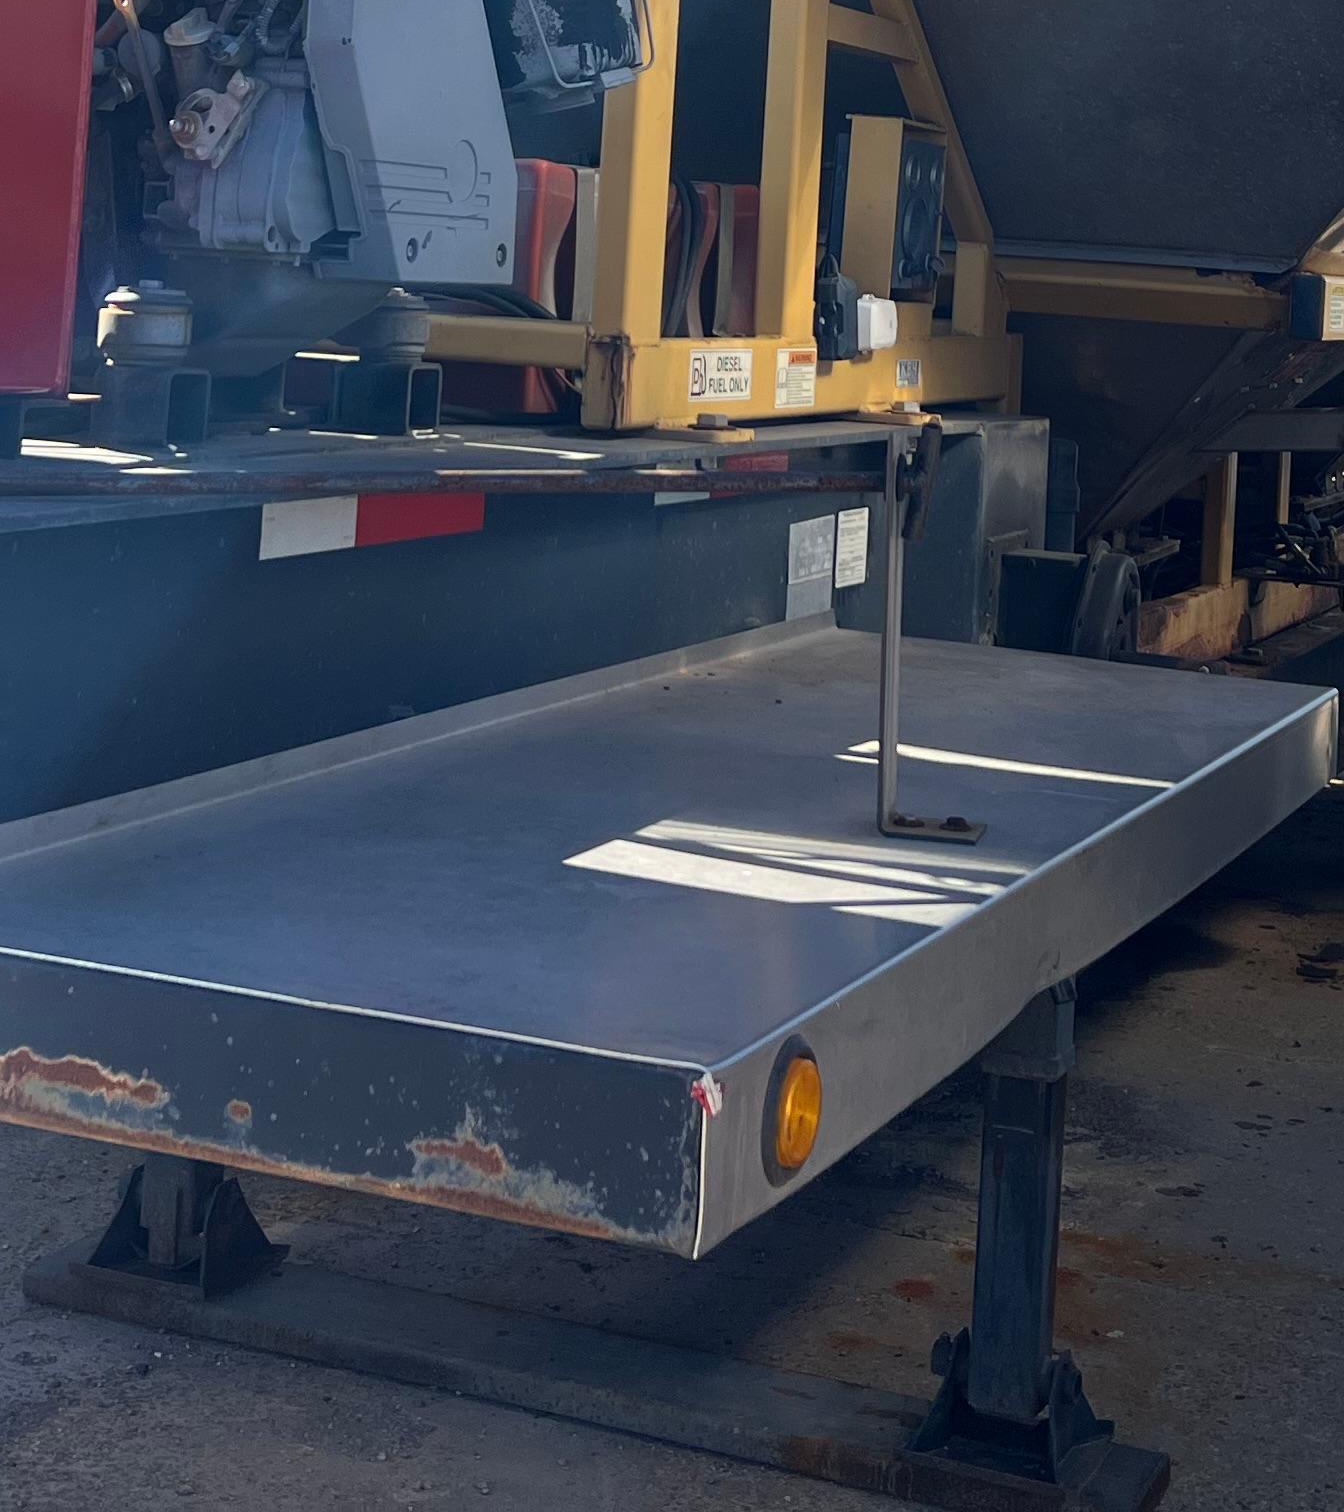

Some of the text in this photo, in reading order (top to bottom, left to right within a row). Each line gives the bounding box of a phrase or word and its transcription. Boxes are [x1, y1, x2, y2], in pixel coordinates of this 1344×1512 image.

[716, 356, 742, 372] DIESEL
[708, 376, 749, 394] FUEL ONLY
